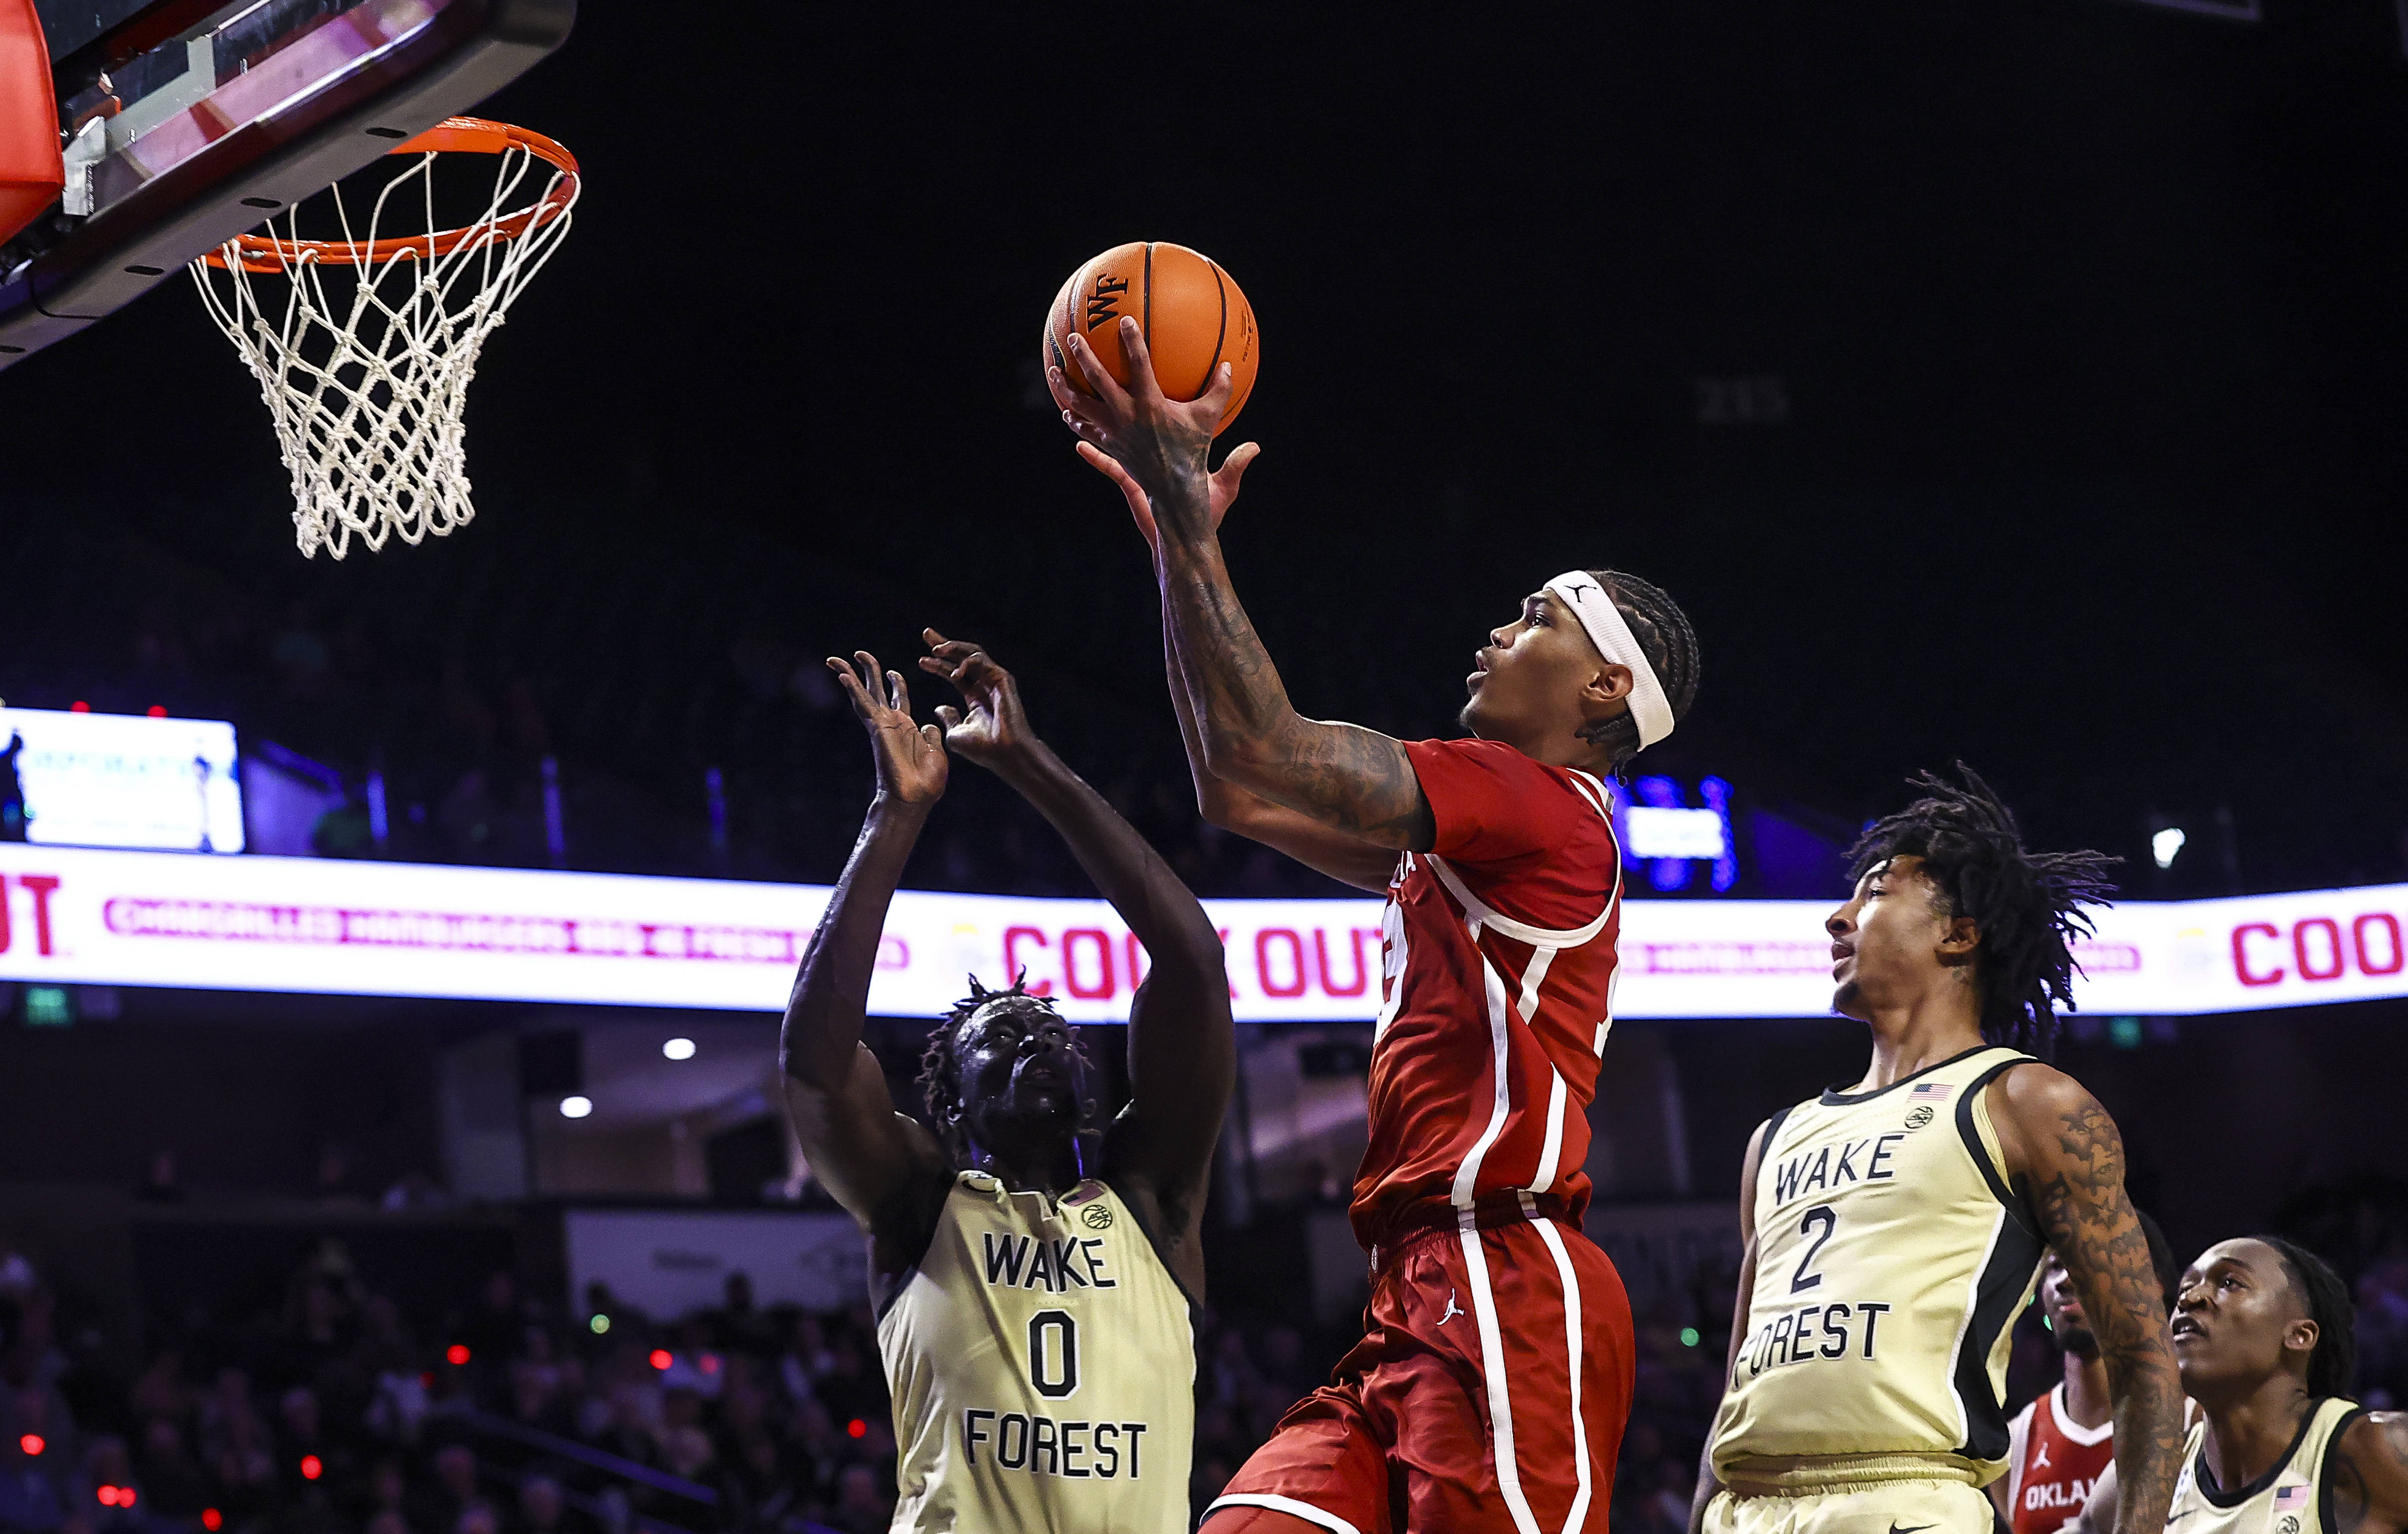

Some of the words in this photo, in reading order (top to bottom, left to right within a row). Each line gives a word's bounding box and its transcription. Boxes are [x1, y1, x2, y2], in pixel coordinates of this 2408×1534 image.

[1776, 1134, 1905, 1205] WAKE
[983, 1231, 1118, 1293] WAKE
[1790, 1205, 1838, 1296] 2
[1028, 1309, 1081, 1401] 0
[965, 1409, 1147, 1479] FOREST
